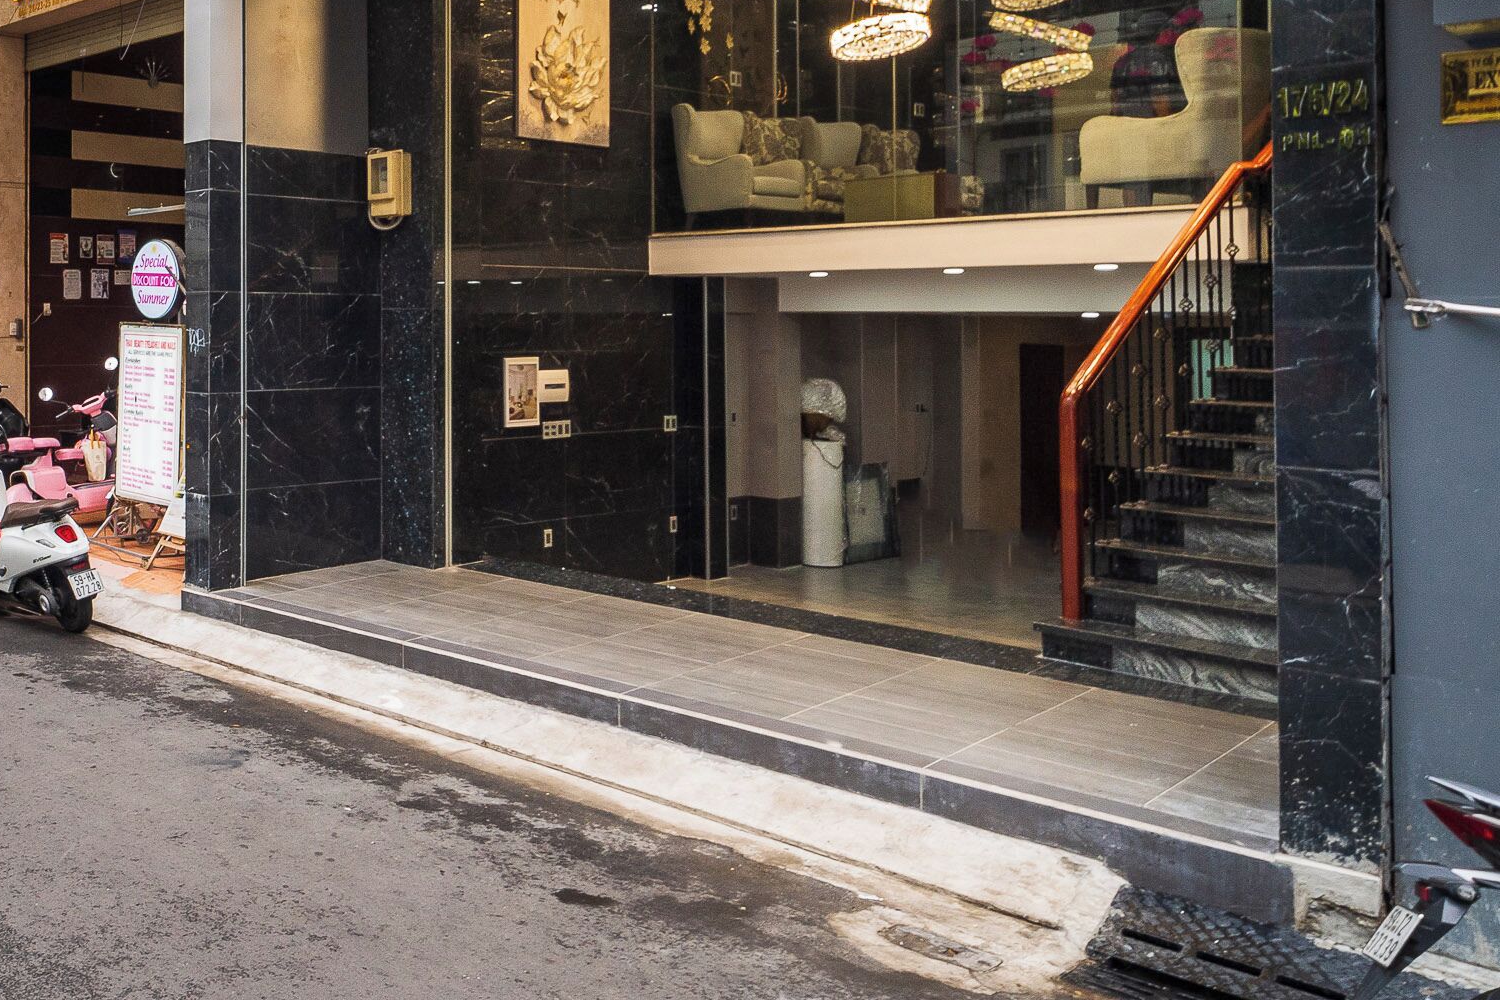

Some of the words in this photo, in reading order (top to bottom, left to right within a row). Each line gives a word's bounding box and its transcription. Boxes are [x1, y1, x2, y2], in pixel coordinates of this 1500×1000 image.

[140, 254, 169, 270] Special
[160, 274, 174, 287] FOR
[137, 289, 170, 305] Summer
[74, 571, 96, 586] 59-HA
